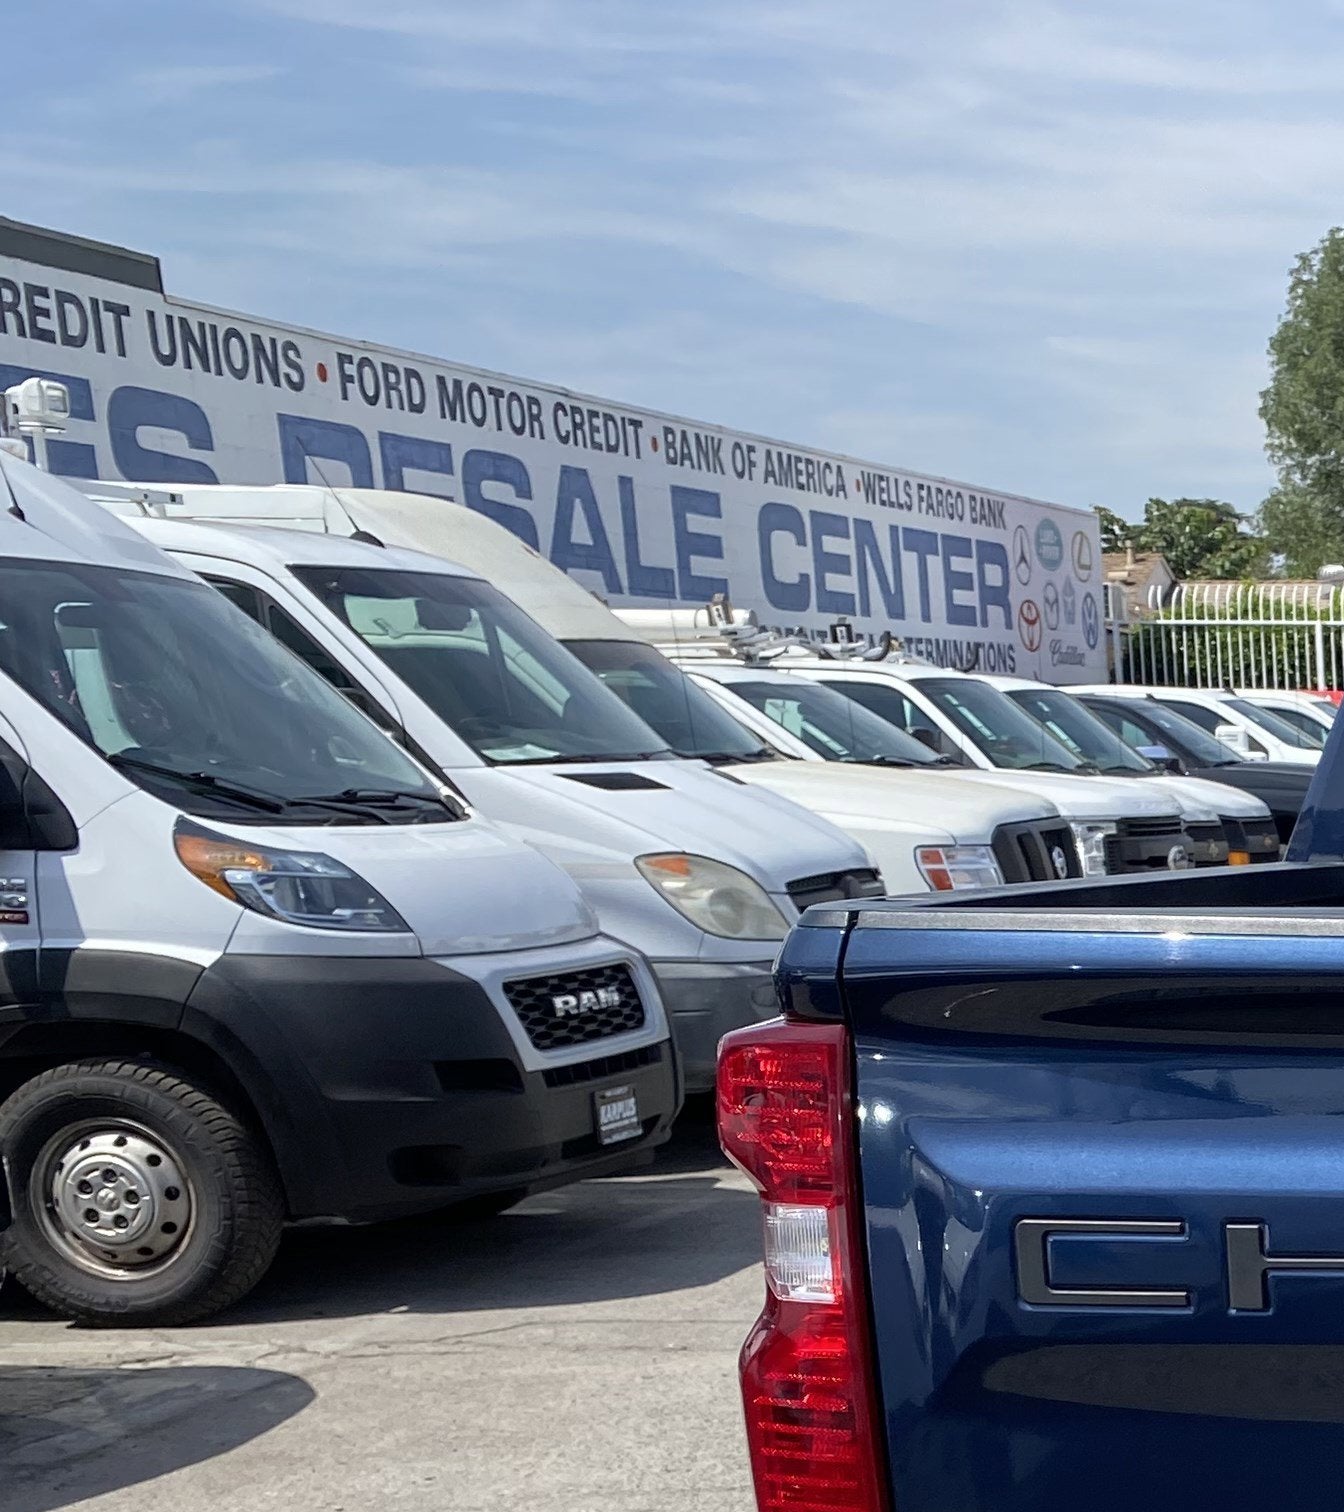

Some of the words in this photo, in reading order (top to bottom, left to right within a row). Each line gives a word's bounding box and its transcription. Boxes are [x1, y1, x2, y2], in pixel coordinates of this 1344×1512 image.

[146, 309, 305, 392] UNIONS
[336, 352, 426, 414] FORD
[435, 374, 546, 440] MOTOR
[553, 401, 643, 460] CREDIT
[663, 426, 724, 476] BANK
[731, 441, 756, 481] OF
[763, 450, 848, 500] AMERICA
[861, 470, 912, 512] WELLS
[917, 482, 965, 522] FARGO
[969, 495, 1007, 530] BANK
[757, 502, 1014, 630] CENTER
[553, 986, 620, 1017] RAM
